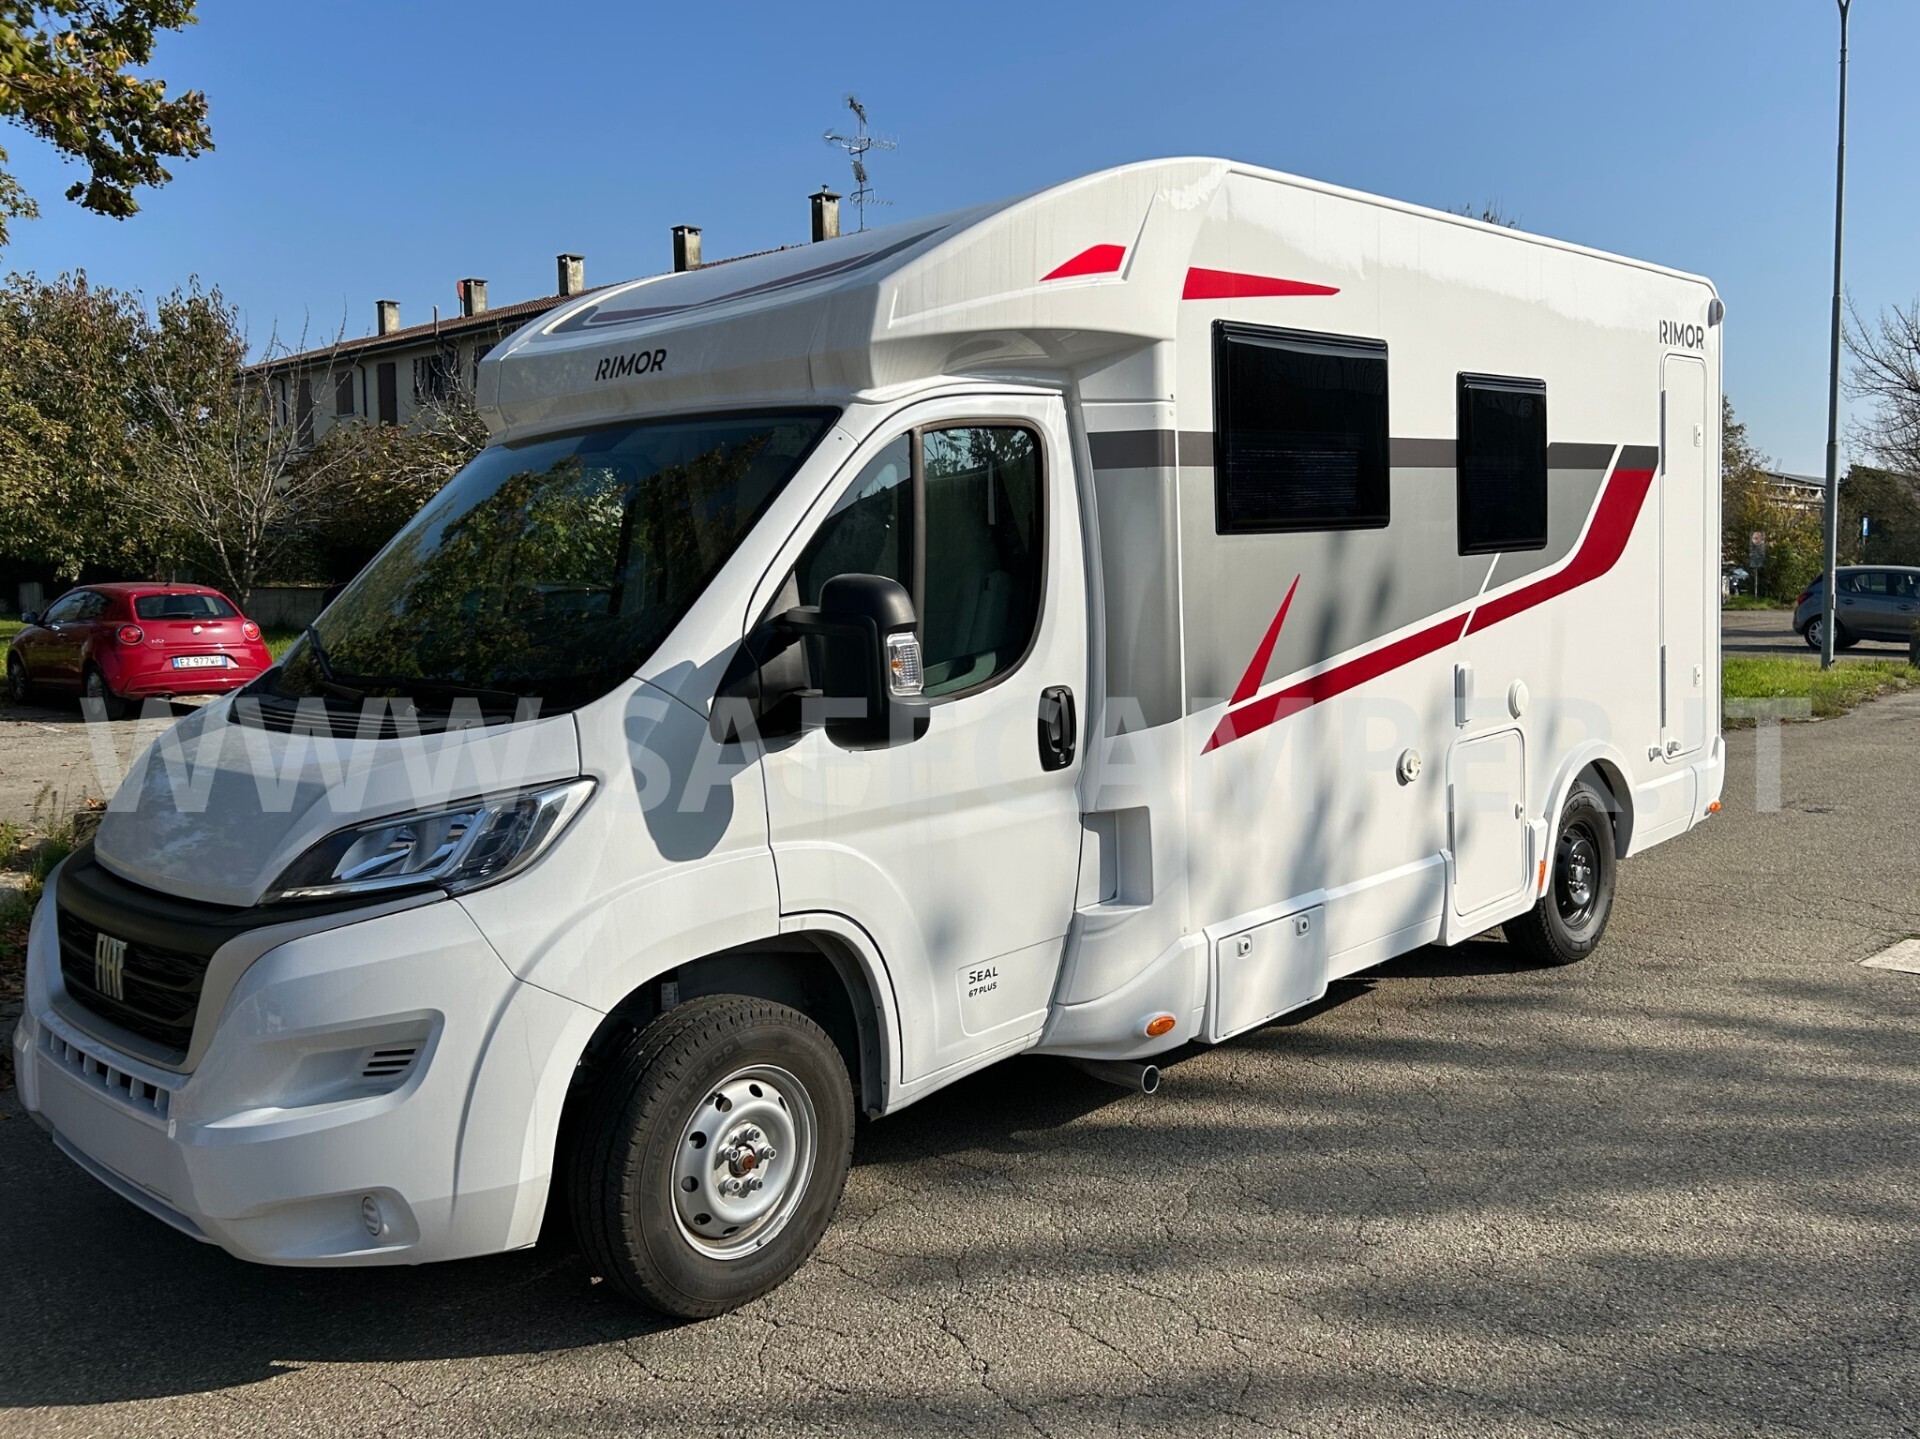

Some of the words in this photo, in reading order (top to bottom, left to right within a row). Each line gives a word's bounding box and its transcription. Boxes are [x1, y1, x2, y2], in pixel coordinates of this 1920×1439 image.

[1659, 319, 1705, 350] RIMOR
[594, 348, 667, 381] RIMOR
[95, 932, 128, 1001] FIAT
[968, 966, 999, 985] SEAL
[968, 988, 978, 998] 67
[978, 981, 998, 995] PLUS
